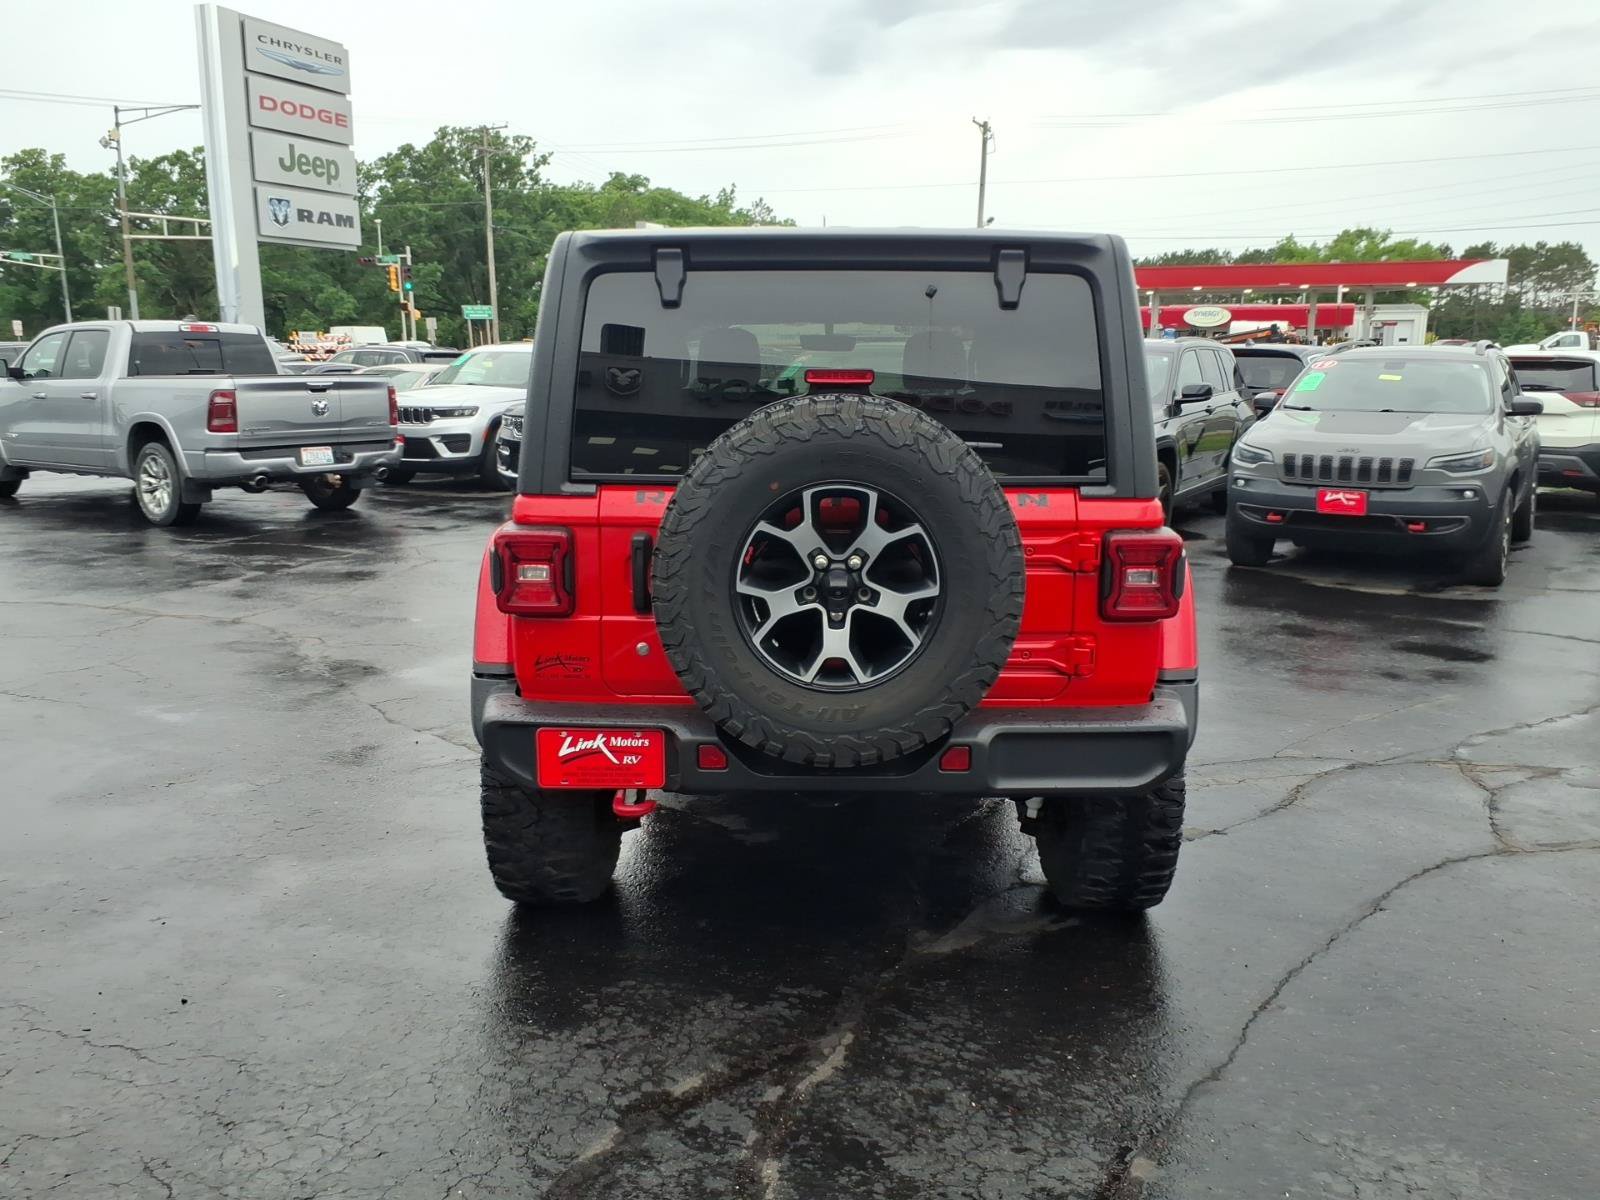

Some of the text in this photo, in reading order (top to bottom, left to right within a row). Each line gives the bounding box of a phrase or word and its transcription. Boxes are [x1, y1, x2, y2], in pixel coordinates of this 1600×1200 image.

[257, 34, 343, 65] CHRYSLER
[258, 95, 348, 129] DODGE
[278, 143, 340, 186] Jeep
[296, 208, 355, 229] RAM
[558, 733, 650, 765] Link Motors
[623, 755, 642, 765] RV
